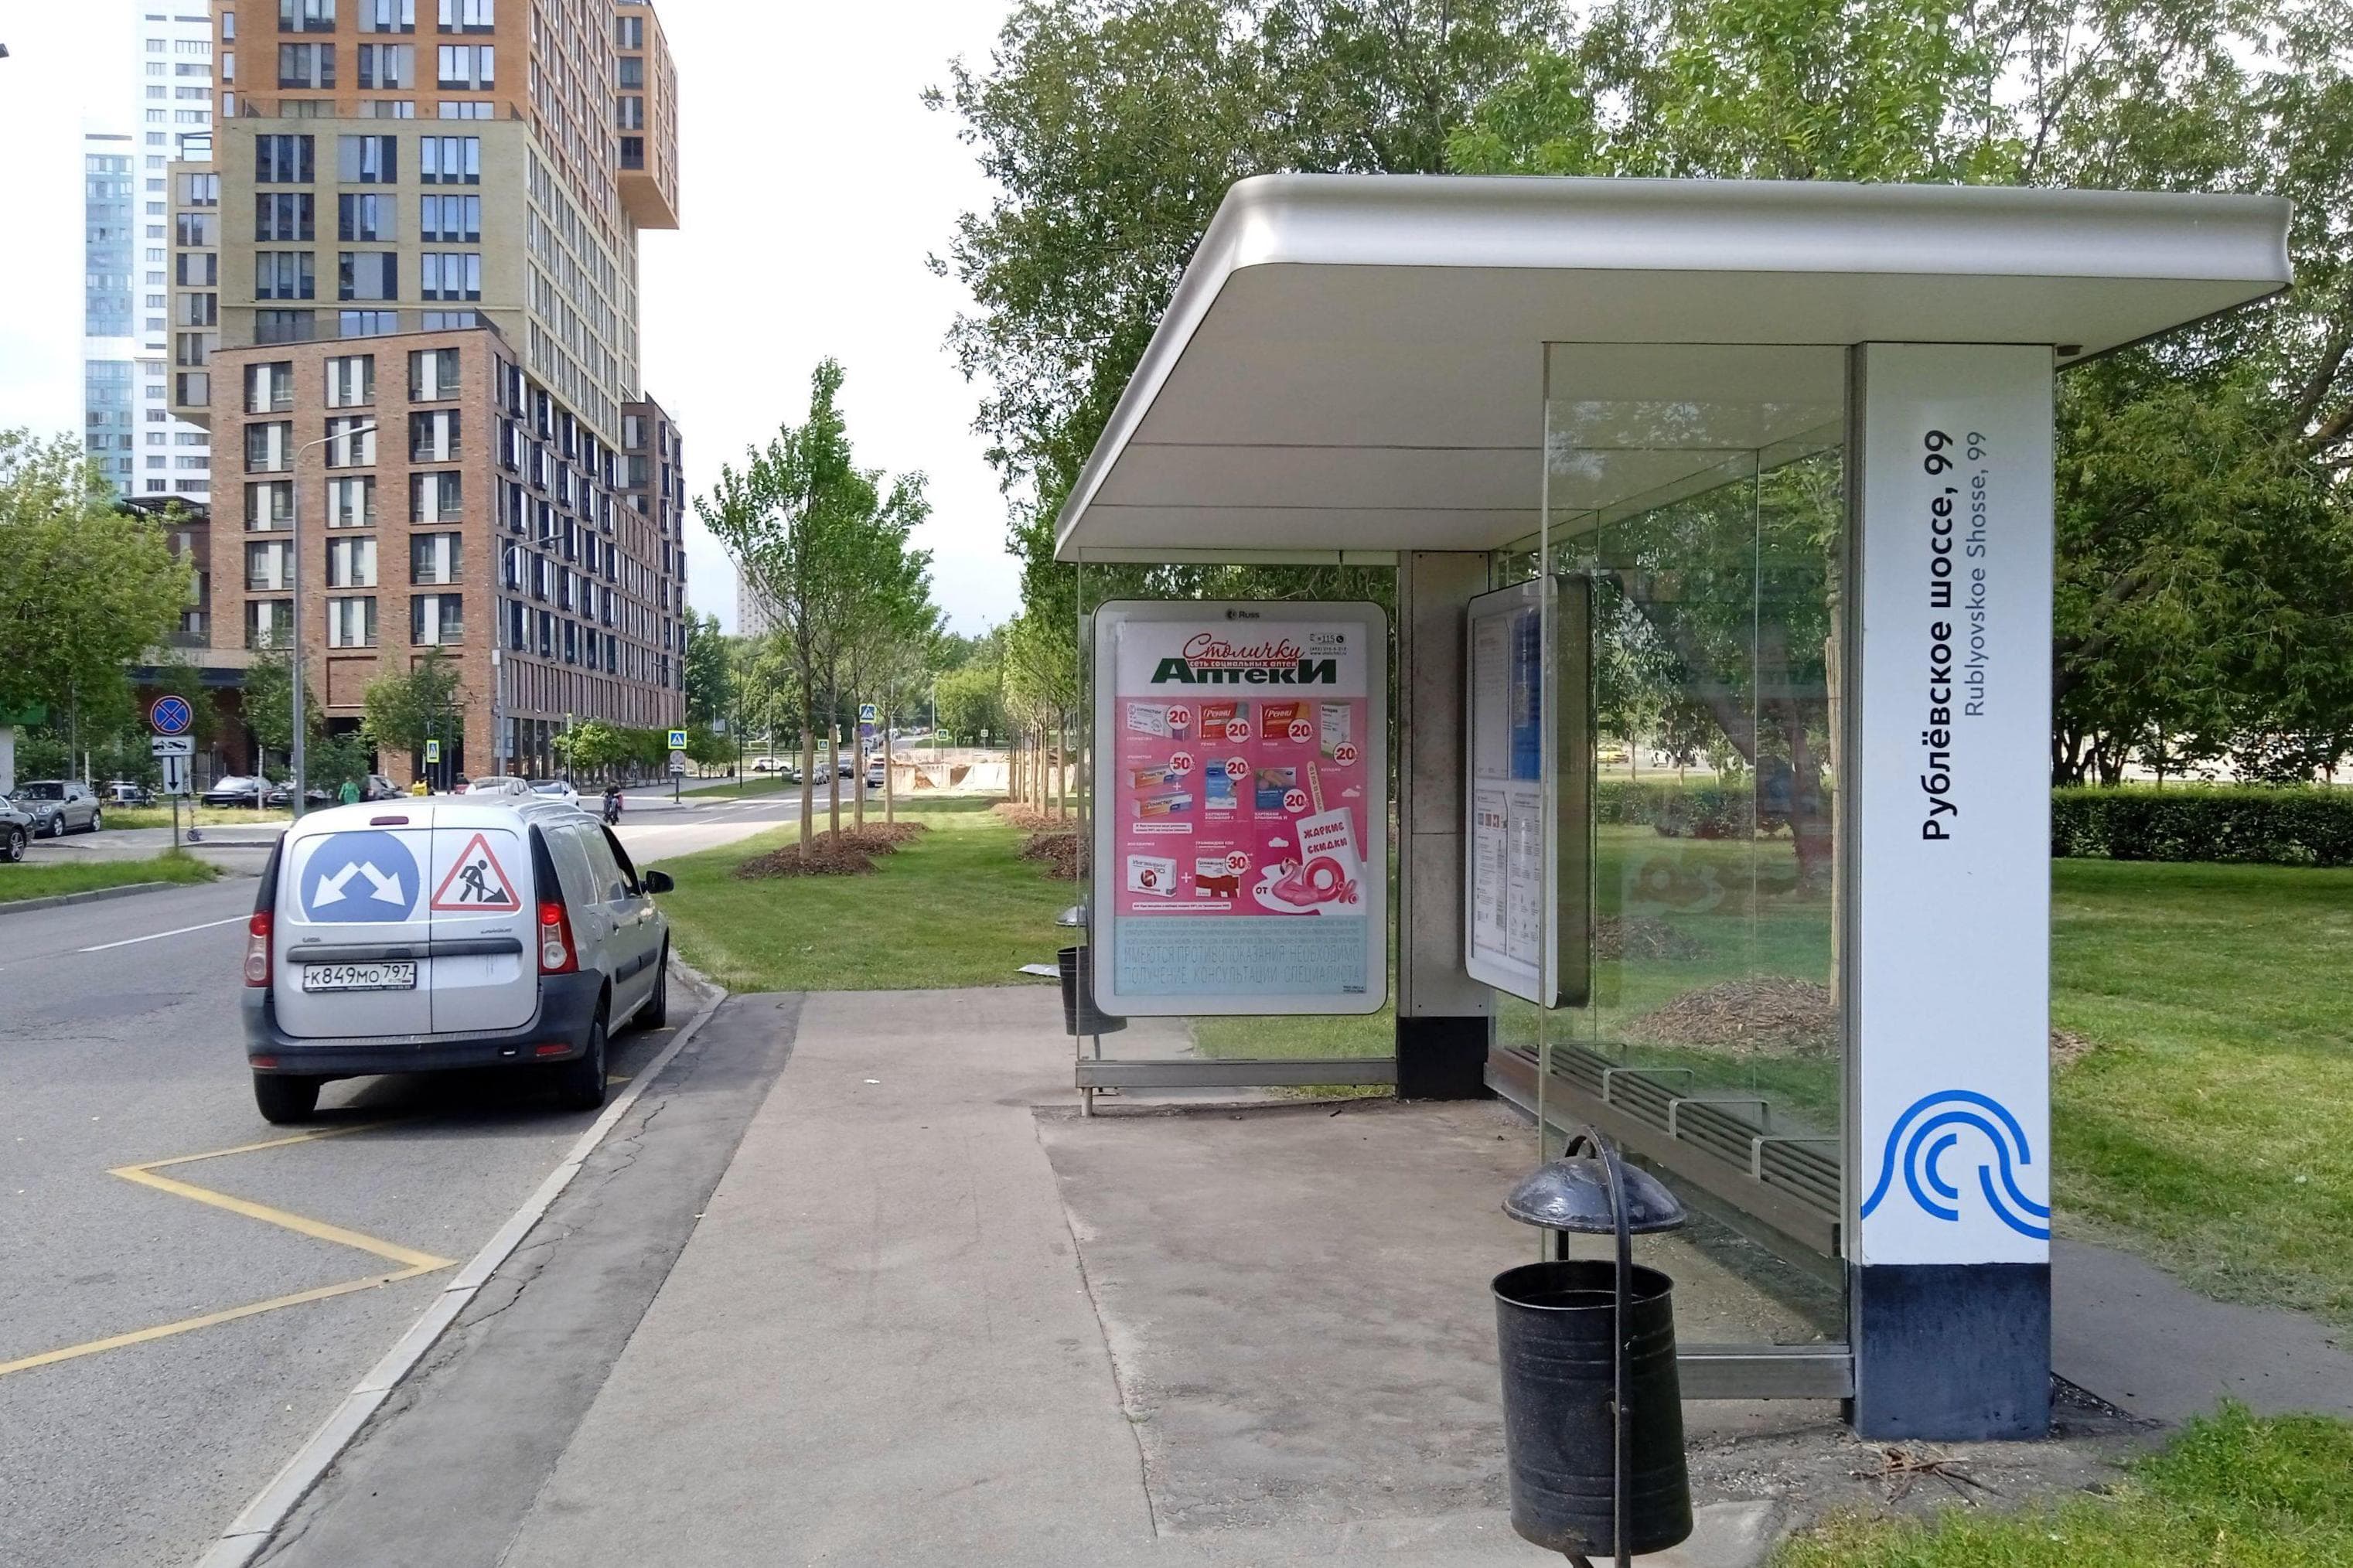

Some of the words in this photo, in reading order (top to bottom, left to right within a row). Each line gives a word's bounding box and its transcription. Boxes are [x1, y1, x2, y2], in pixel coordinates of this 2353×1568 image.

[1923, 429, 1954, 476] 99
[1966, 431, 1987, 462] 99
[1966, 469, 1990, 558] Shosse,
[1929, 486, 1959, 608] шоссе,
[1965, 567, 1990, 717] Rublyovskoe
[1211, 660, 1268, 669] социальных
[1270, 660, 1298, 669] аптек
[1922, 620, 1958, 840] Рублёвское
[1304, 821, 1345, 839] ЖАРКИЕ
[1307, 837, 1348, 854] СКИДКИ
[1124, 946, 1175, 963] ИМЕЮТСЯ
[1124, 966, 1188, 984] ПОЛУЧЕНИЕ
[1194, 966, 1277, 983] КОНСУЛЬТАЦИИ
[1284, 966, 1360, 983] СПЕЦИАЛИСТА
